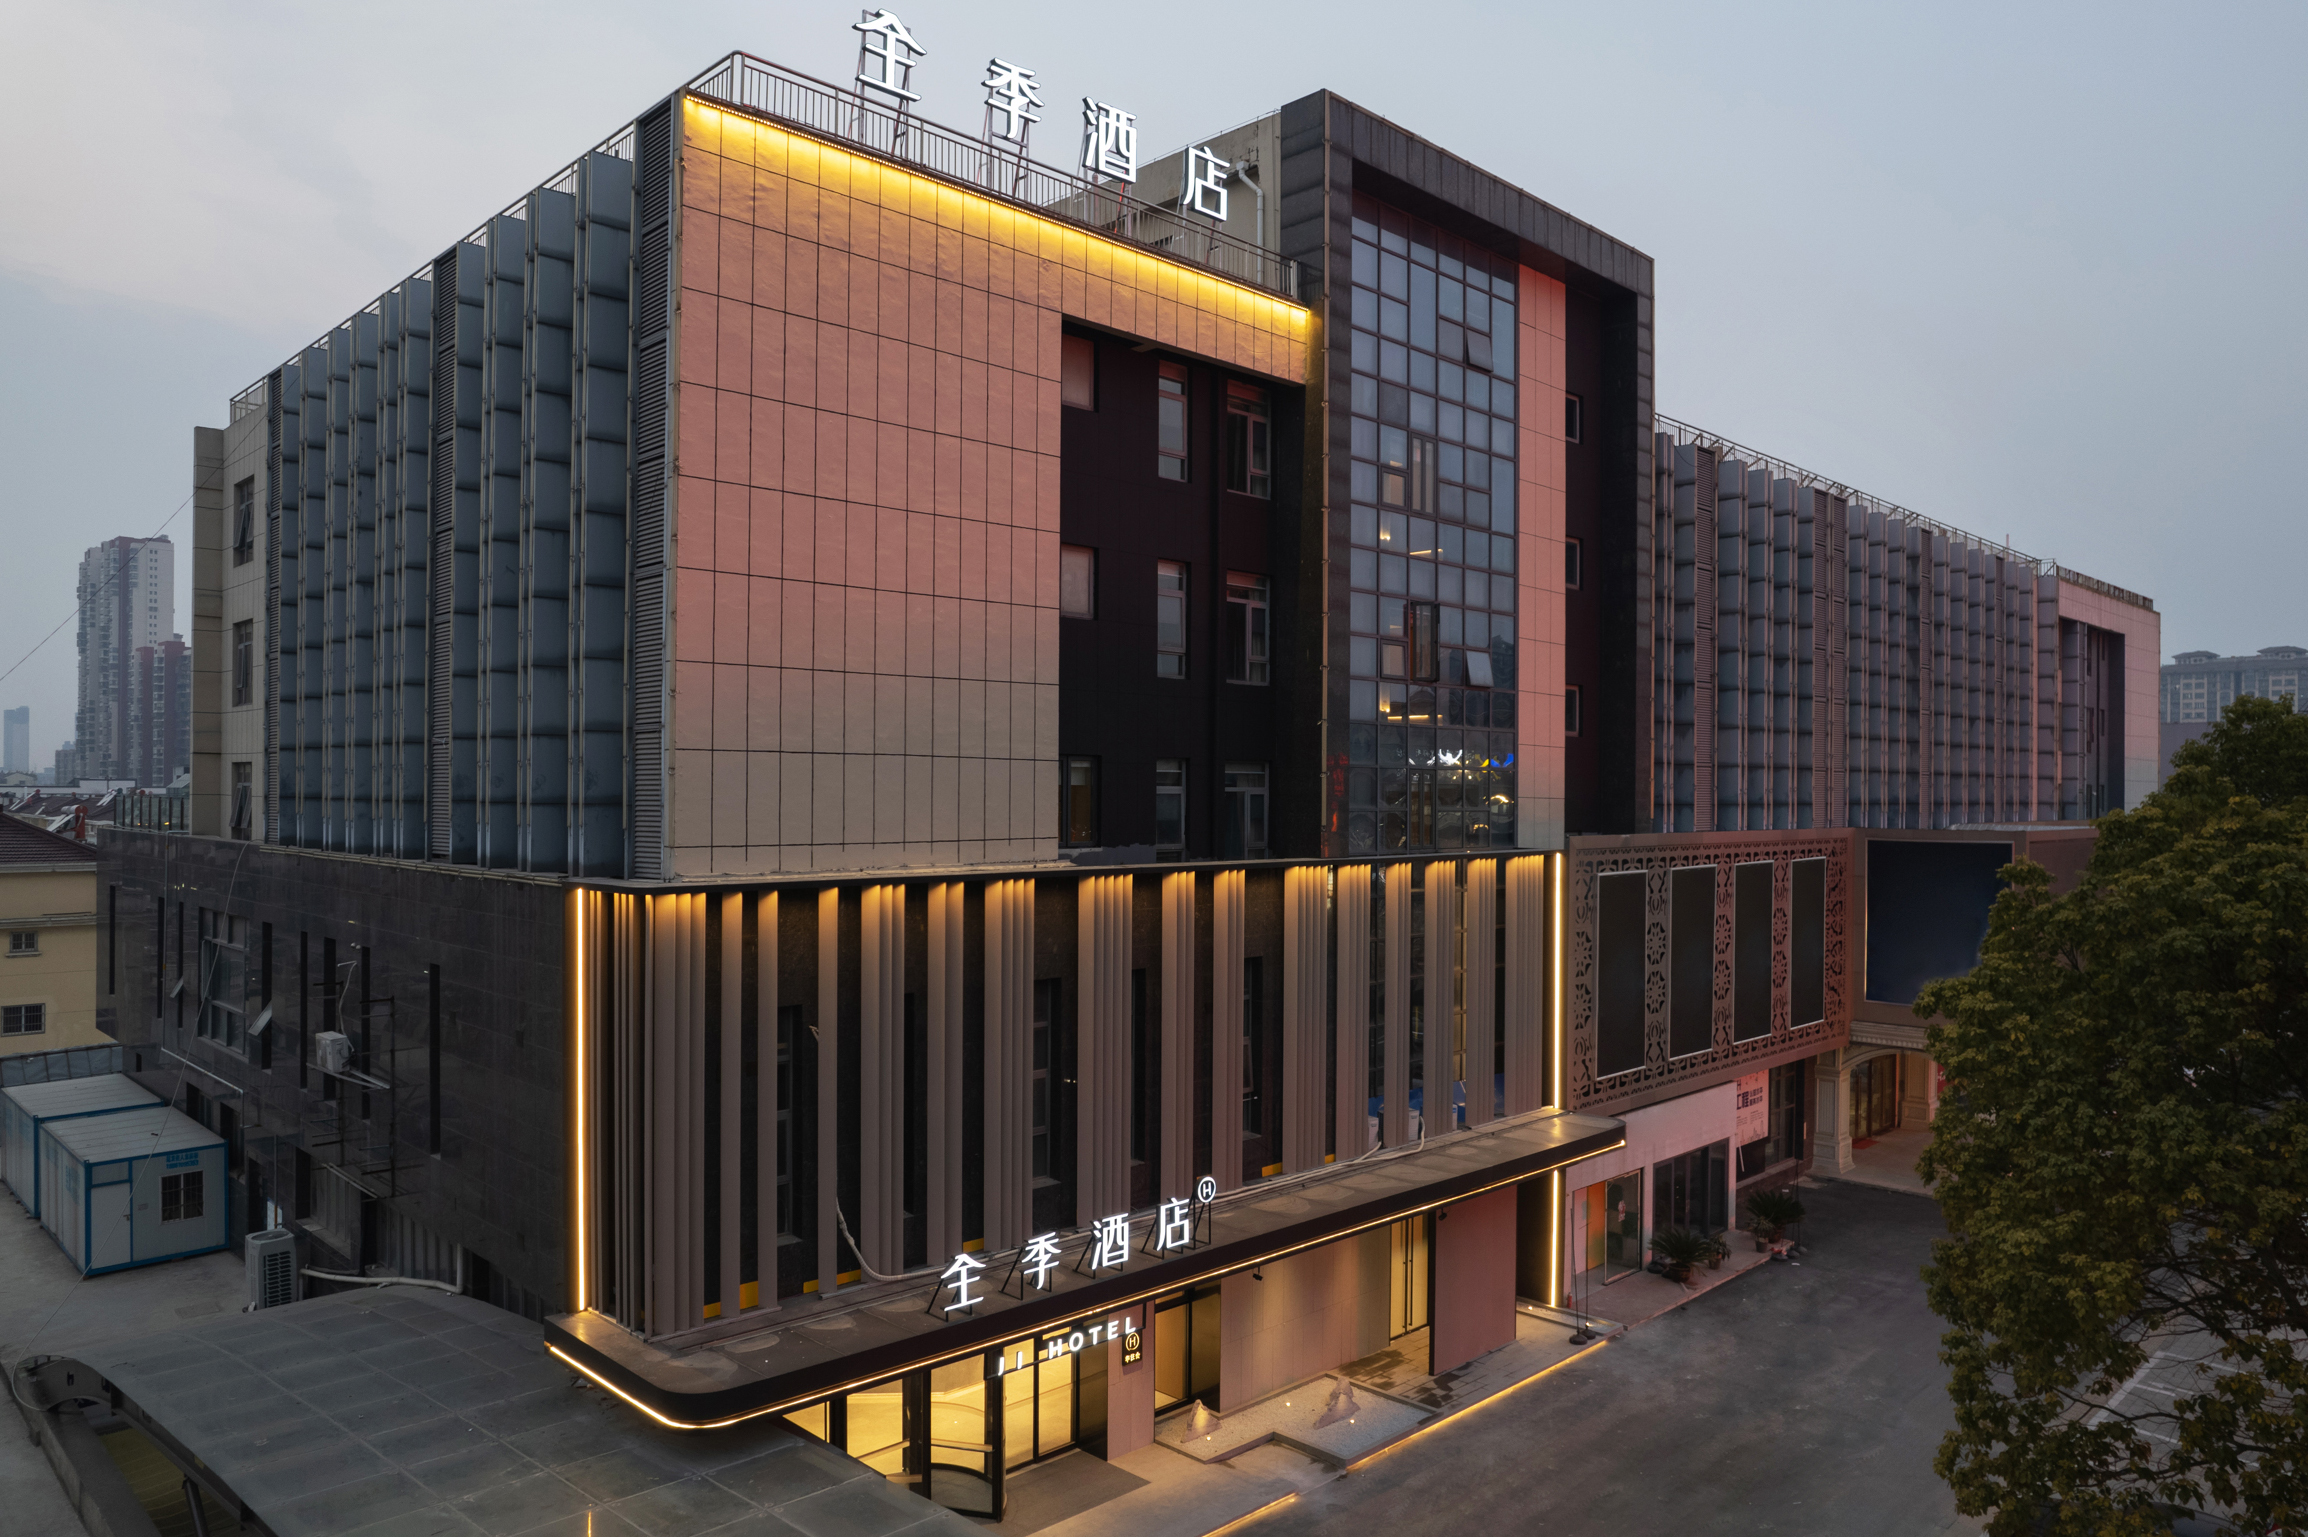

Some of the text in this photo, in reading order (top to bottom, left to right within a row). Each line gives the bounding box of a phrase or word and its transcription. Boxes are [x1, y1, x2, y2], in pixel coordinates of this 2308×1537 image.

[852, 8, 1231, 222] 全季酒店
[940, 1197, 1190, 1311] 全季酒店
[998, 1316, 1137, 1376] JI HOTEL
